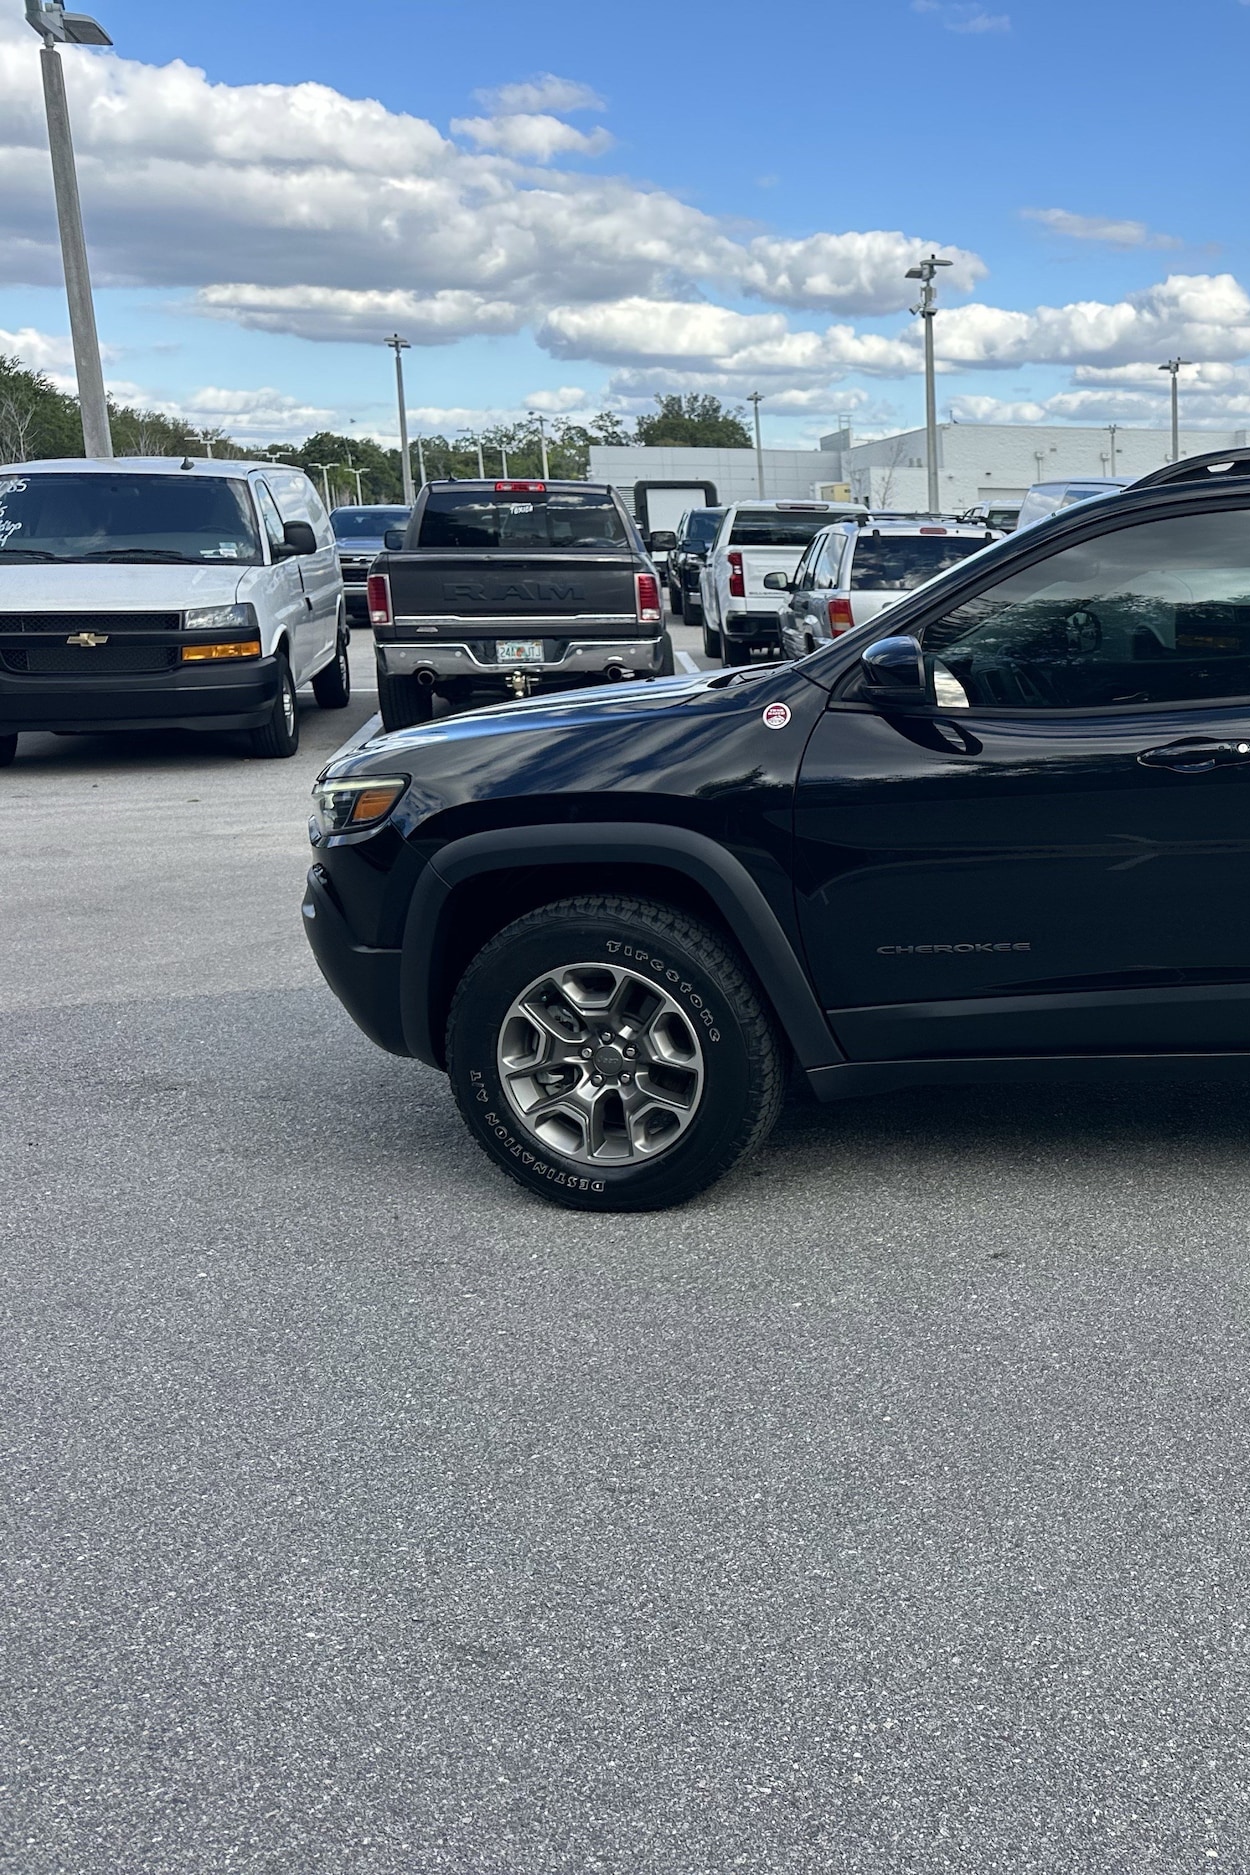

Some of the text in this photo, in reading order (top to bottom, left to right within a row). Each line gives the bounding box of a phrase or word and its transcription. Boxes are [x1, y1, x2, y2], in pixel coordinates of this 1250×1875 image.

[443, 583, 586, 600] RAM
[876, 942, 1032, 954] CHEROKEE
[606, 940, 721, 1042] Firestone
[469, 1069, 607, 1193] DESTINATION A/T
